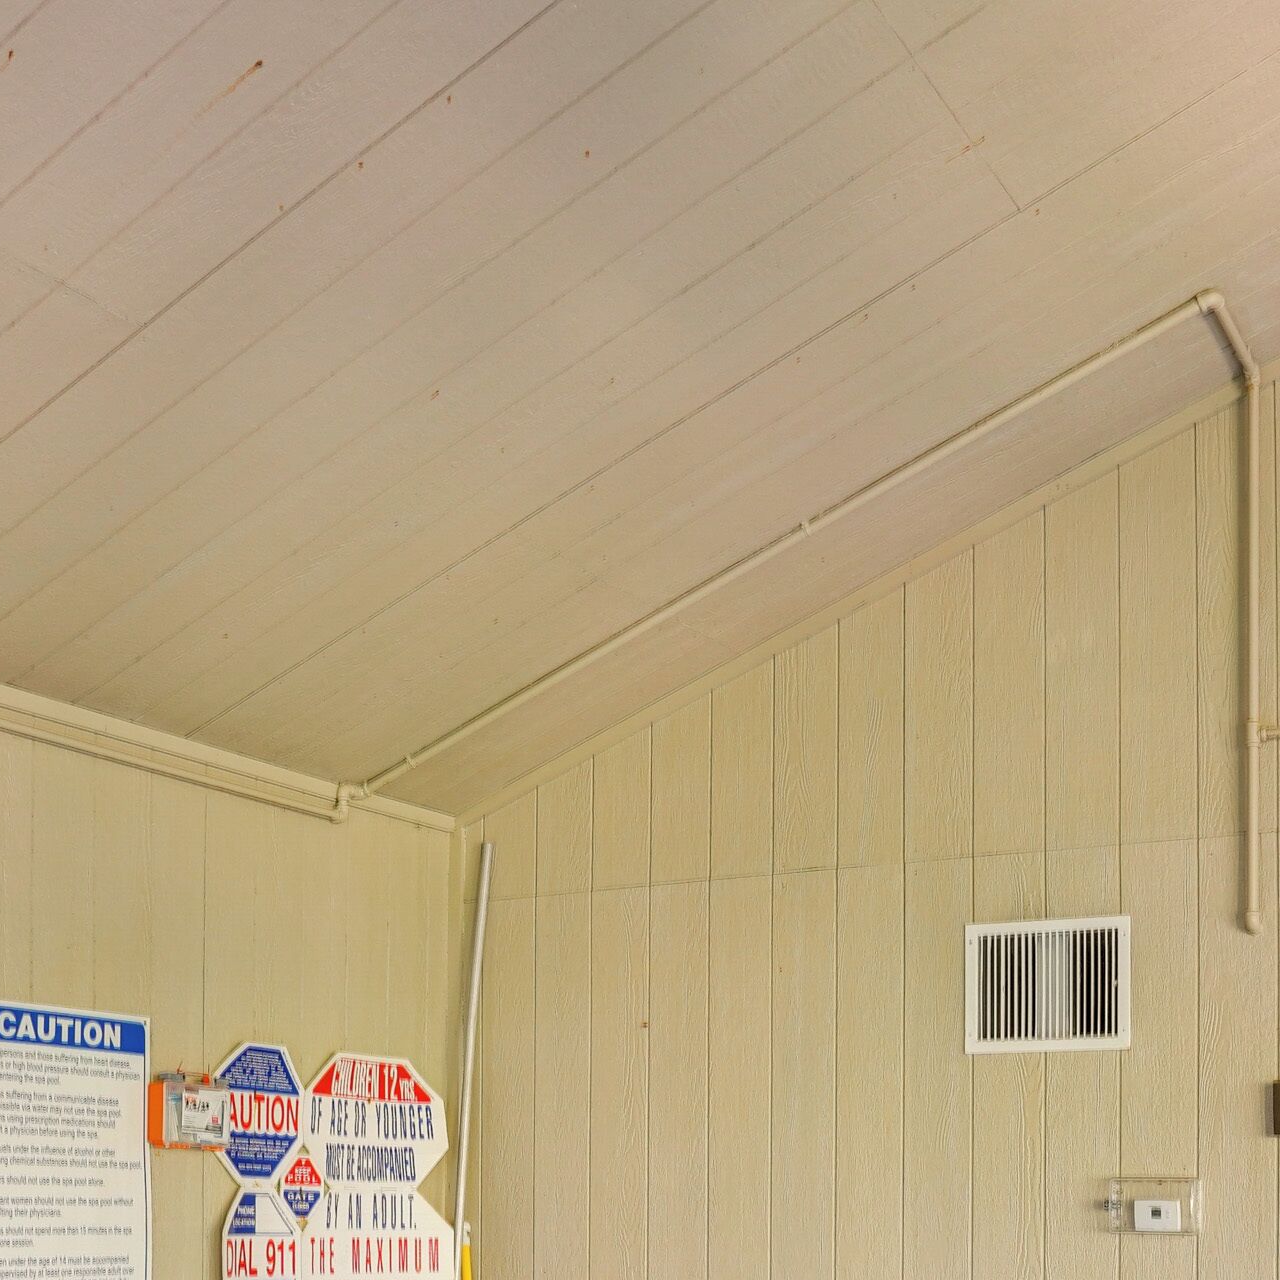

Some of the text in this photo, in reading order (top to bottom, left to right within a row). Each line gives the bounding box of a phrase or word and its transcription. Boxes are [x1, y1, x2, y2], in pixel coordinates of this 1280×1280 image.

[331, 1058, 379, 1099] CHILDREN
[383, 1064, 398, 1099] 12
[399, 1077, 416, 1101] YRS.
[230, 1092, 298, 1133] AUTION
[310, 1097, 434, 1140] OF AGE OR YOUNGER
[288, 1174, 317, 1184] POOL
[326, 1143, 345, 1178] MUST
[346, 1145, 357, 1180] BE
[357, 1146, 416, 1183] ACCOMPANIED
[14, 1208, 28, 1216] their
[33, 1196, 53, 1205] should
[54, 1196, 64, 1205] not
[77, 1197, 87, 1205] the
[88, 1198, 98, 1208] spa
[99, 1197, 112, 1208] pool
[113, 1197, 133, 1206] without
[238, 1206, 255, 1215] PHONE
[288, 1192, 315, 1201] GATE
[326, 1192, 417, 1231] BY AN ADULT.
[227, 1238, 296, 1278] DIAL 911
[310, 1237, 440, 1275] THE MAXIMUM
